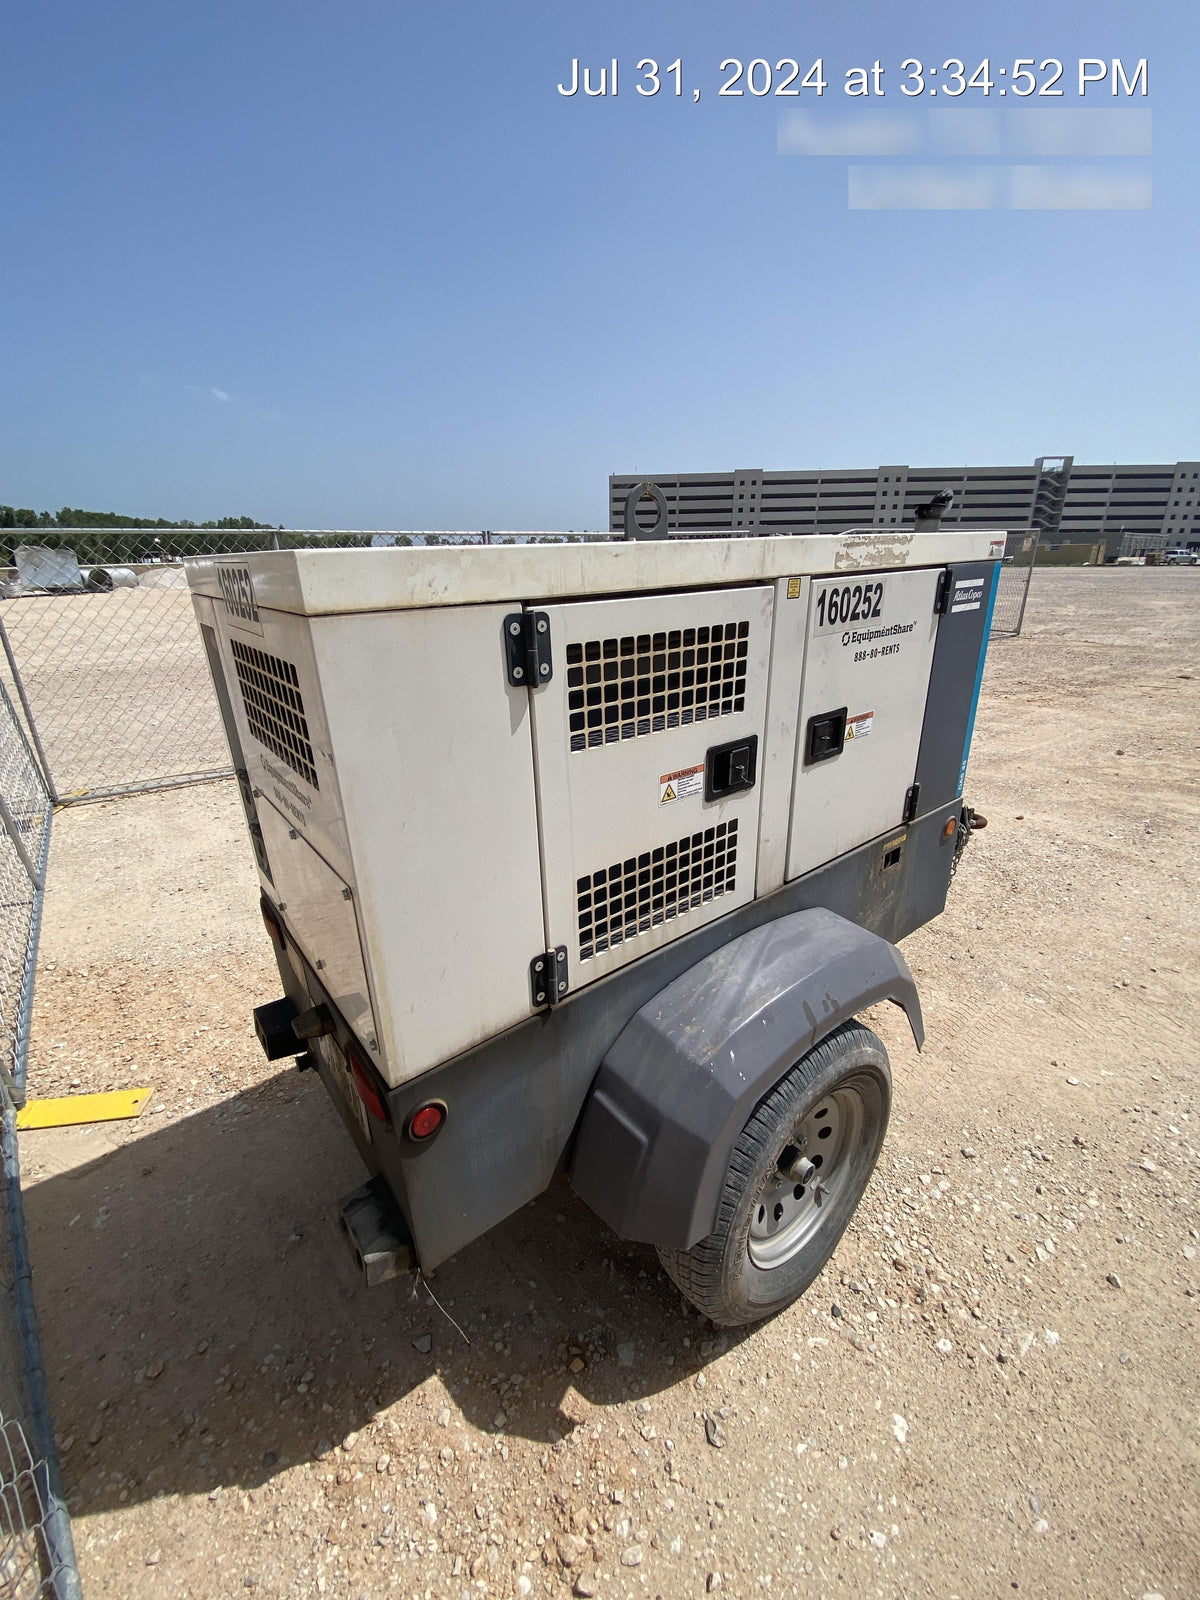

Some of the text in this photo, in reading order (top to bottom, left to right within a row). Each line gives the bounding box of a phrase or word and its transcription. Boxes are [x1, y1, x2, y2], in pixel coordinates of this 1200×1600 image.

[217, 567, 260, 623] 160252
[817, 582, 884, 627] 160252
[853, 643, 900, 663] 888-80-RENTS
